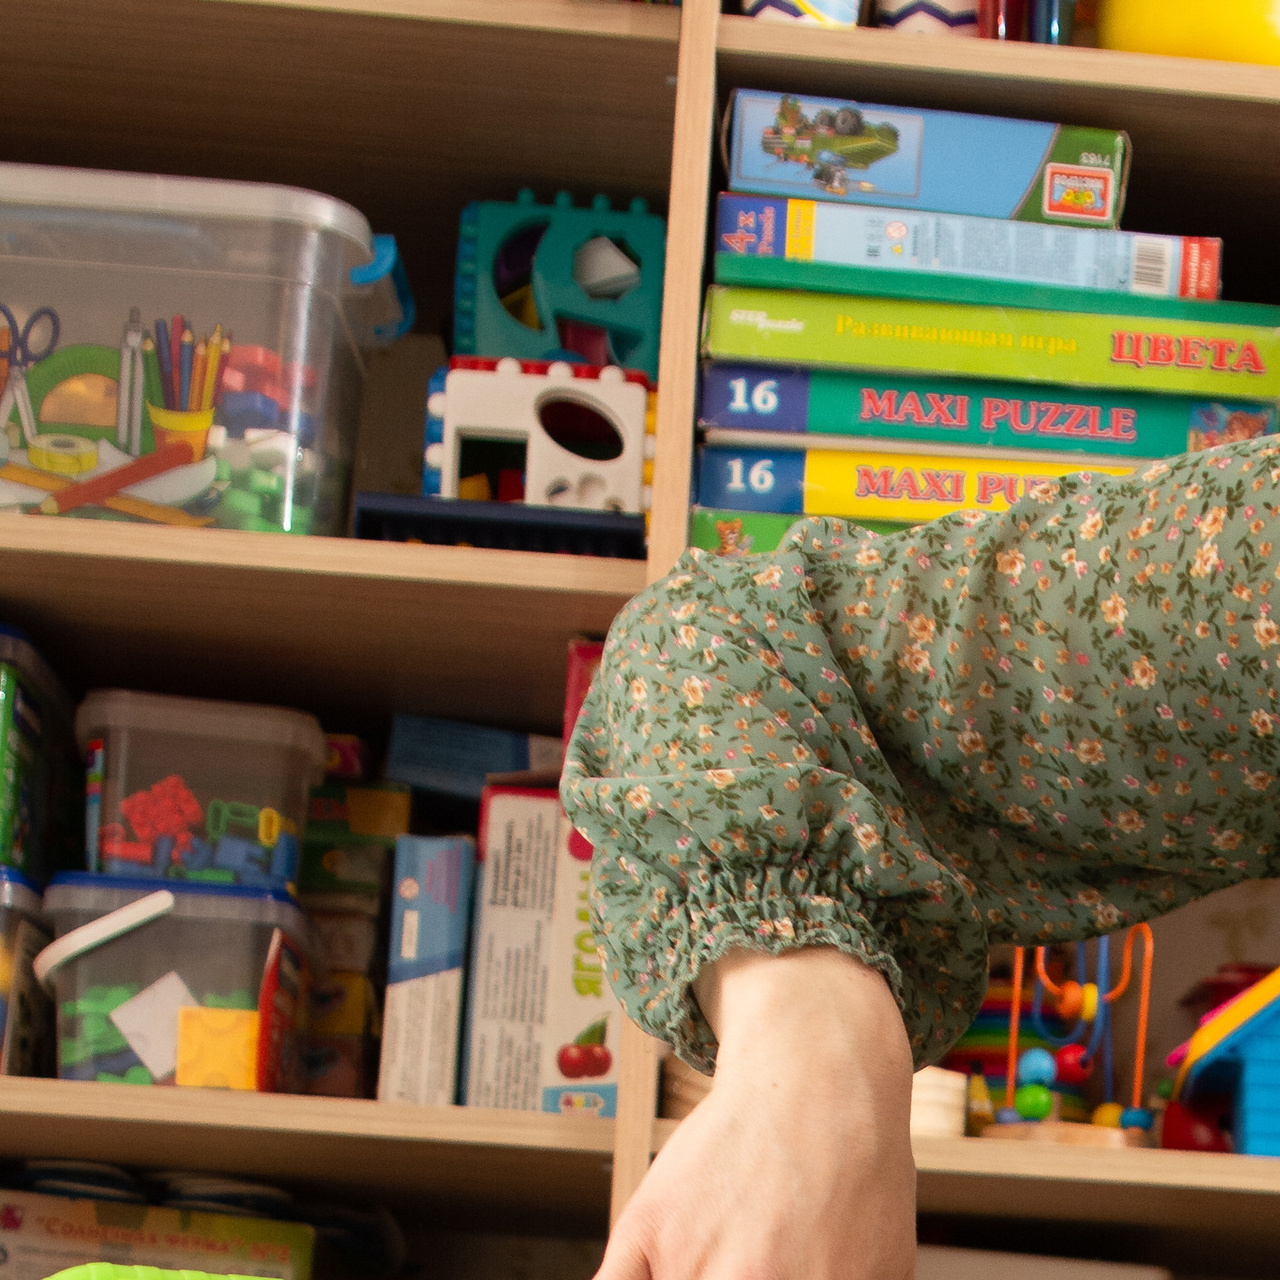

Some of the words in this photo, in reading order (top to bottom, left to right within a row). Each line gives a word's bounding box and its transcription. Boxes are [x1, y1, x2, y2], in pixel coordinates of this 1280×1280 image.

[1111, 329, 1266, 375] ЦВЕТА
[728, 377, 780, 413] 16
[860, 387, 969, 428] MAXI
[981, 396, 1138, 442] PUZZLE
[726, 458, 775, 493] 16
[856, 465, 968, 504] MAXI
